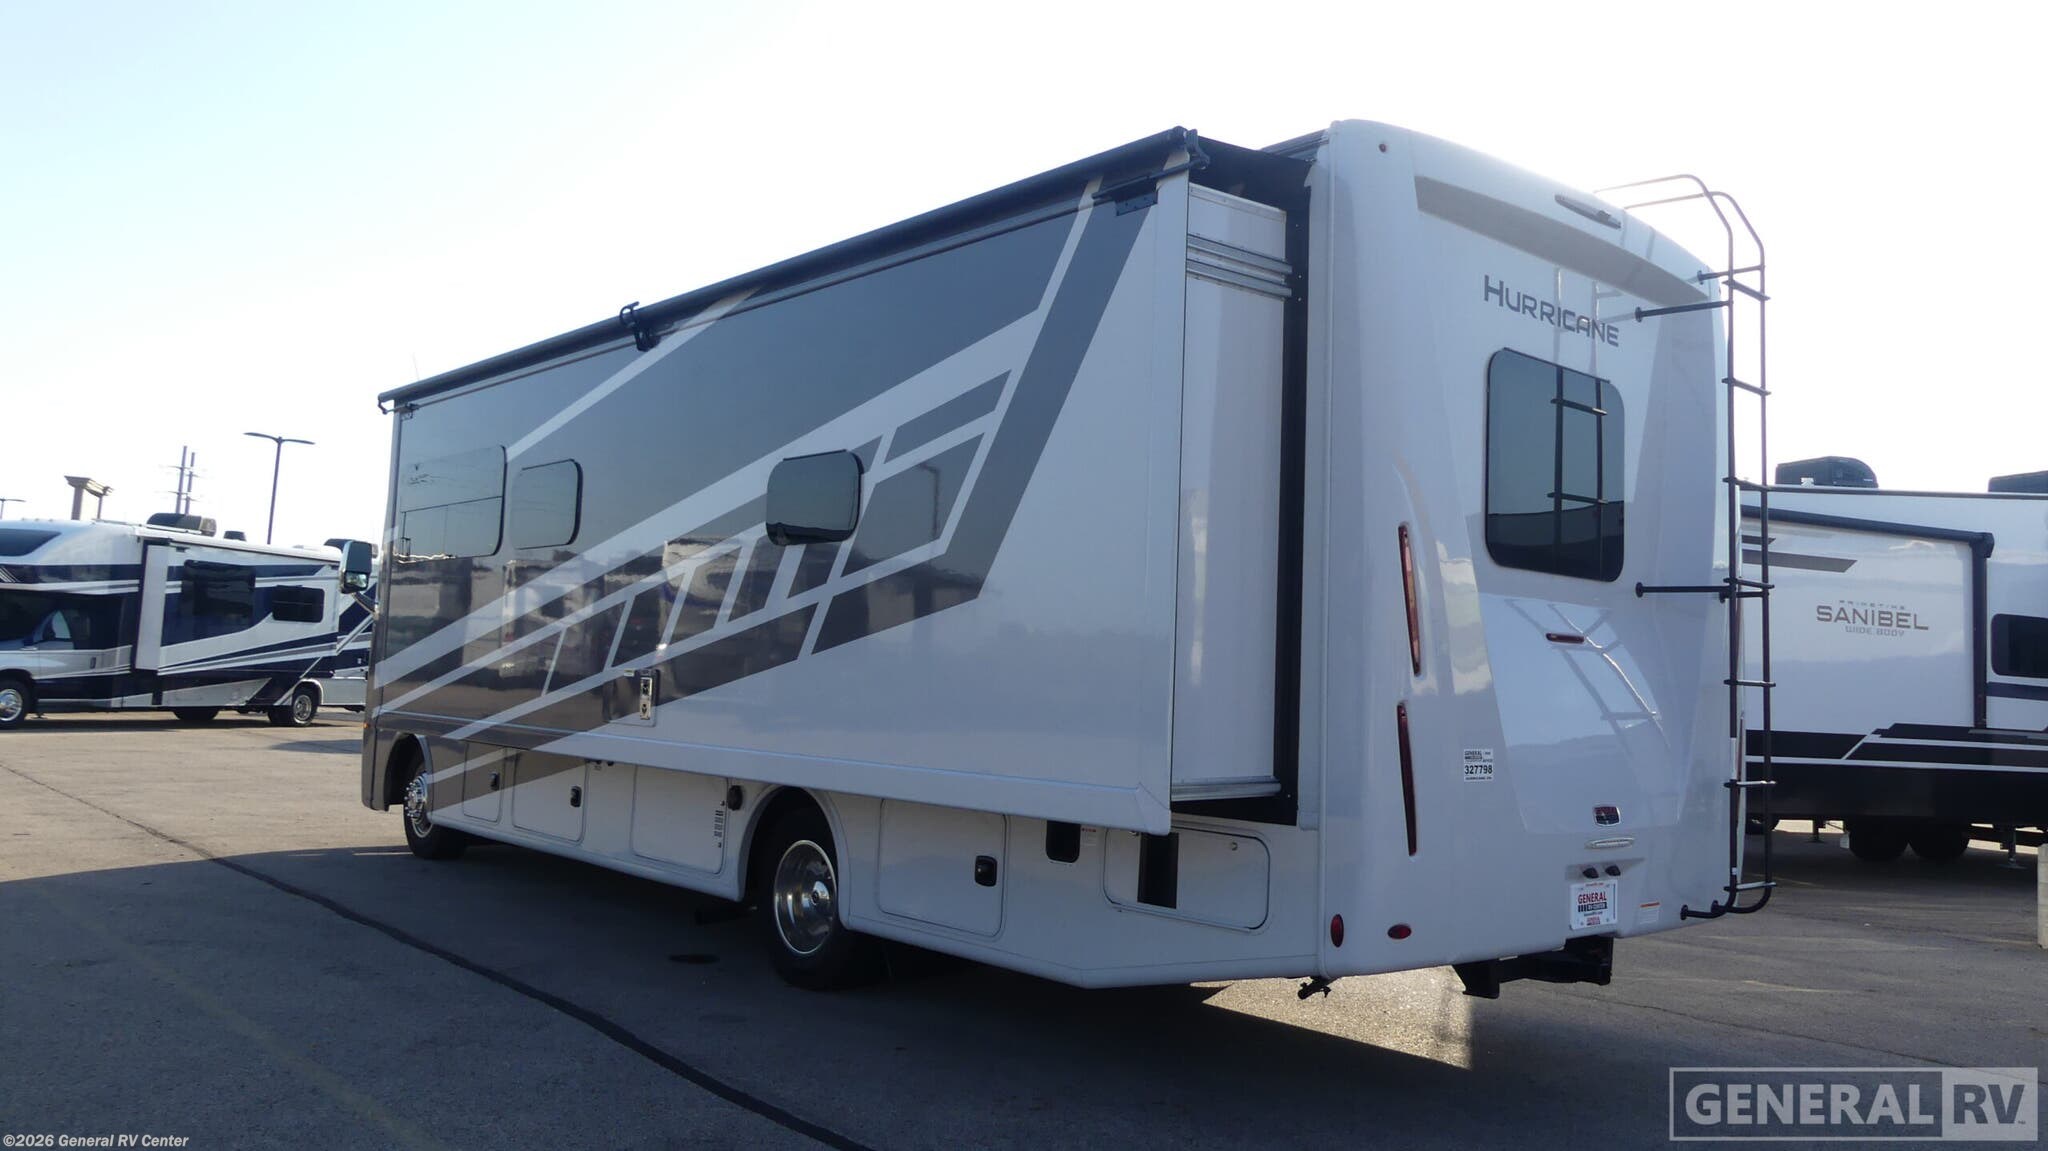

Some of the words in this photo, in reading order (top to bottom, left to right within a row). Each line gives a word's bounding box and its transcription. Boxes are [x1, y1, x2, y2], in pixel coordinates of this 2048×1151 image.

[1484, 274, 1619, 347] HURRICANE
[1816, 605, 1929, 630] SANIBEL
[1845, 625, 1873, 635] WIDE
[1876, 627, 1905, 637] BODY
[1464, 765, 1493, 774] 327798
[1578, 892, 1607, 904] GENERAL
